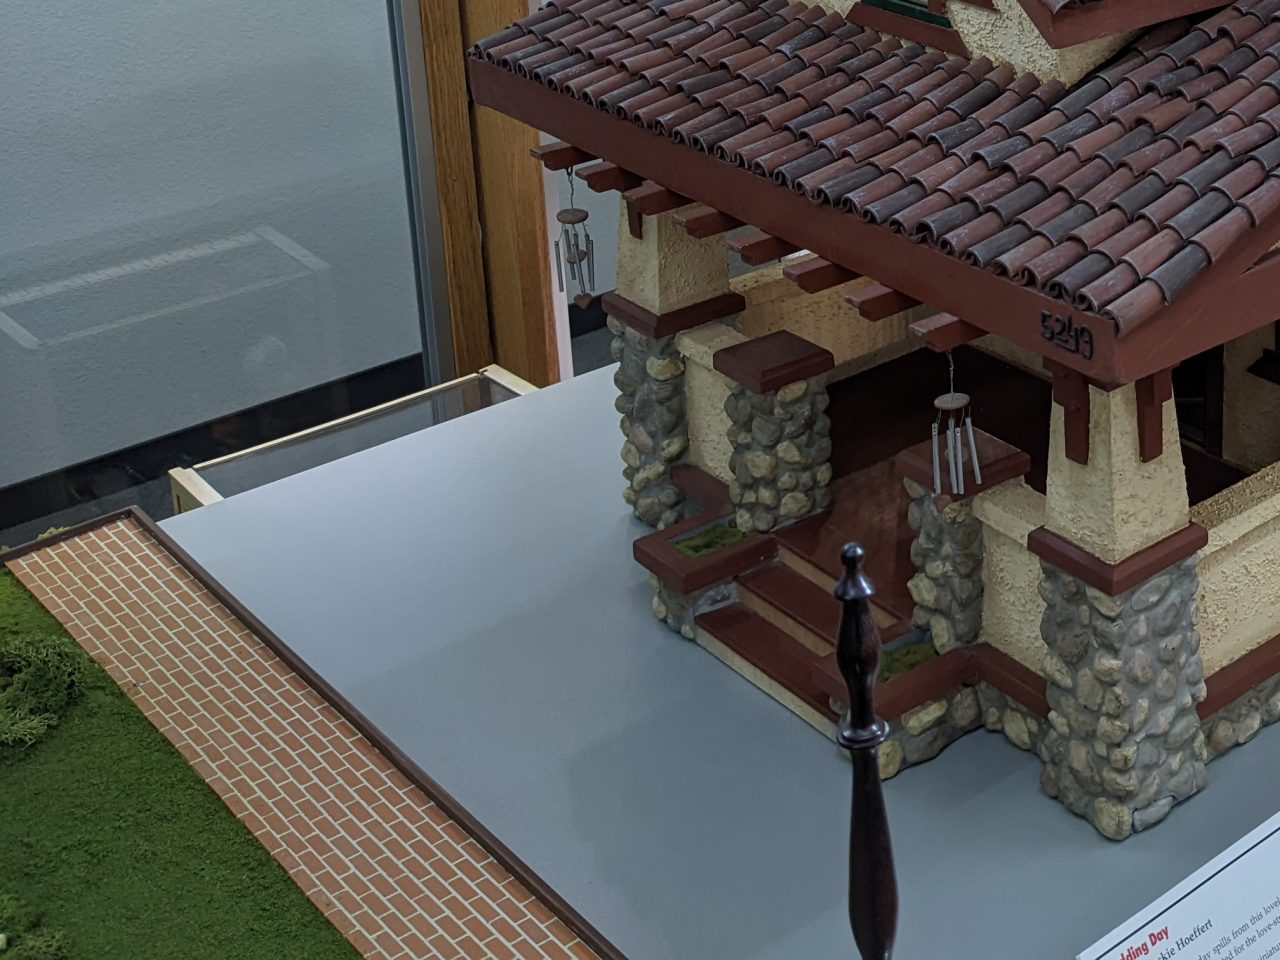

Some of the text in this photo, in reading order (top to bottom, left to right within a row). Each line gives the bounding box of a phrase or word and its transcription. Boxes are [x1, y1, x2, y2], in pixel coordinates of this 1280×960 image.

[1041, 309, 1094, 360] 5249
[1148, 926, 1169, 947] Day
[1175, 918, 1213, 951] Hoeffert
[1213, 935, 1231, 955] spills
[1232, 923, 1250, 942] from
[1250, 912, 1264, 926] this
[1234, 943, 1245, 958] for
[1245, 935, 1257, 948] the
